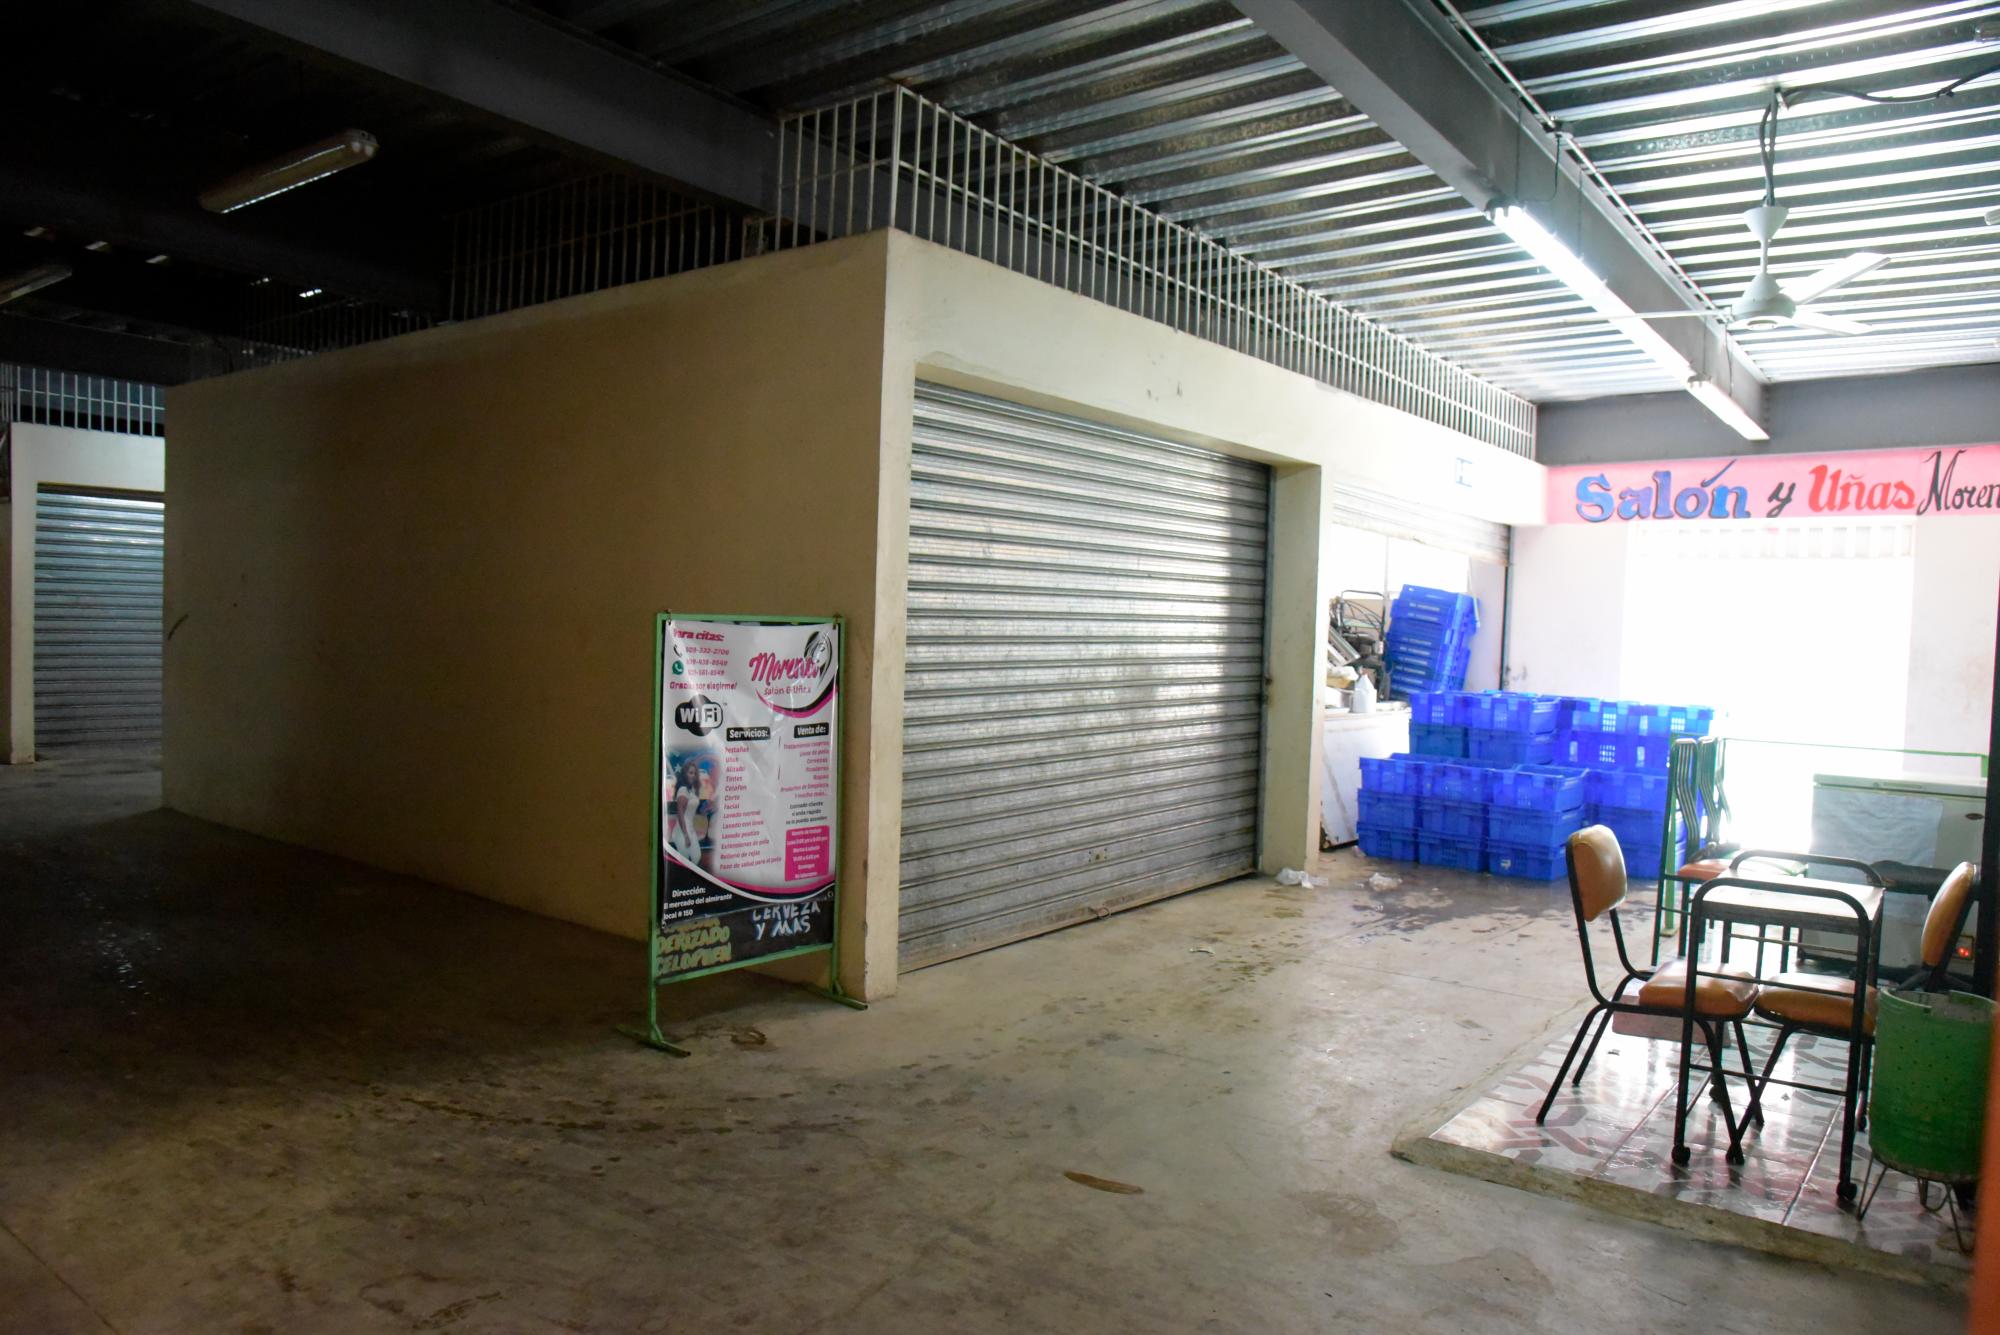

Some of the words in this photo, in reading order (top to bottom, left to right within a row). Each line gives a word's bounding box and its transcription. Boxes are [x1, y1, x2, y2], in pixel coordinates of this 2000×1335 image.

[1575, 459, 1750, 522] Salón
[1766, 482, 1797, 518] y
[1808, 464, 1915, 512] Uñas
[696, 630, 725, 641] citas:
[729, 729, 769, 738] Servicios:
[672, 886, 706, 898] Dirección:
[669, 898, 695, 909] mercado
[663, 911, 677, 920] local
[753, 901, 820, 921] CERVEZA
[771, 915, 811, 938] MAS
